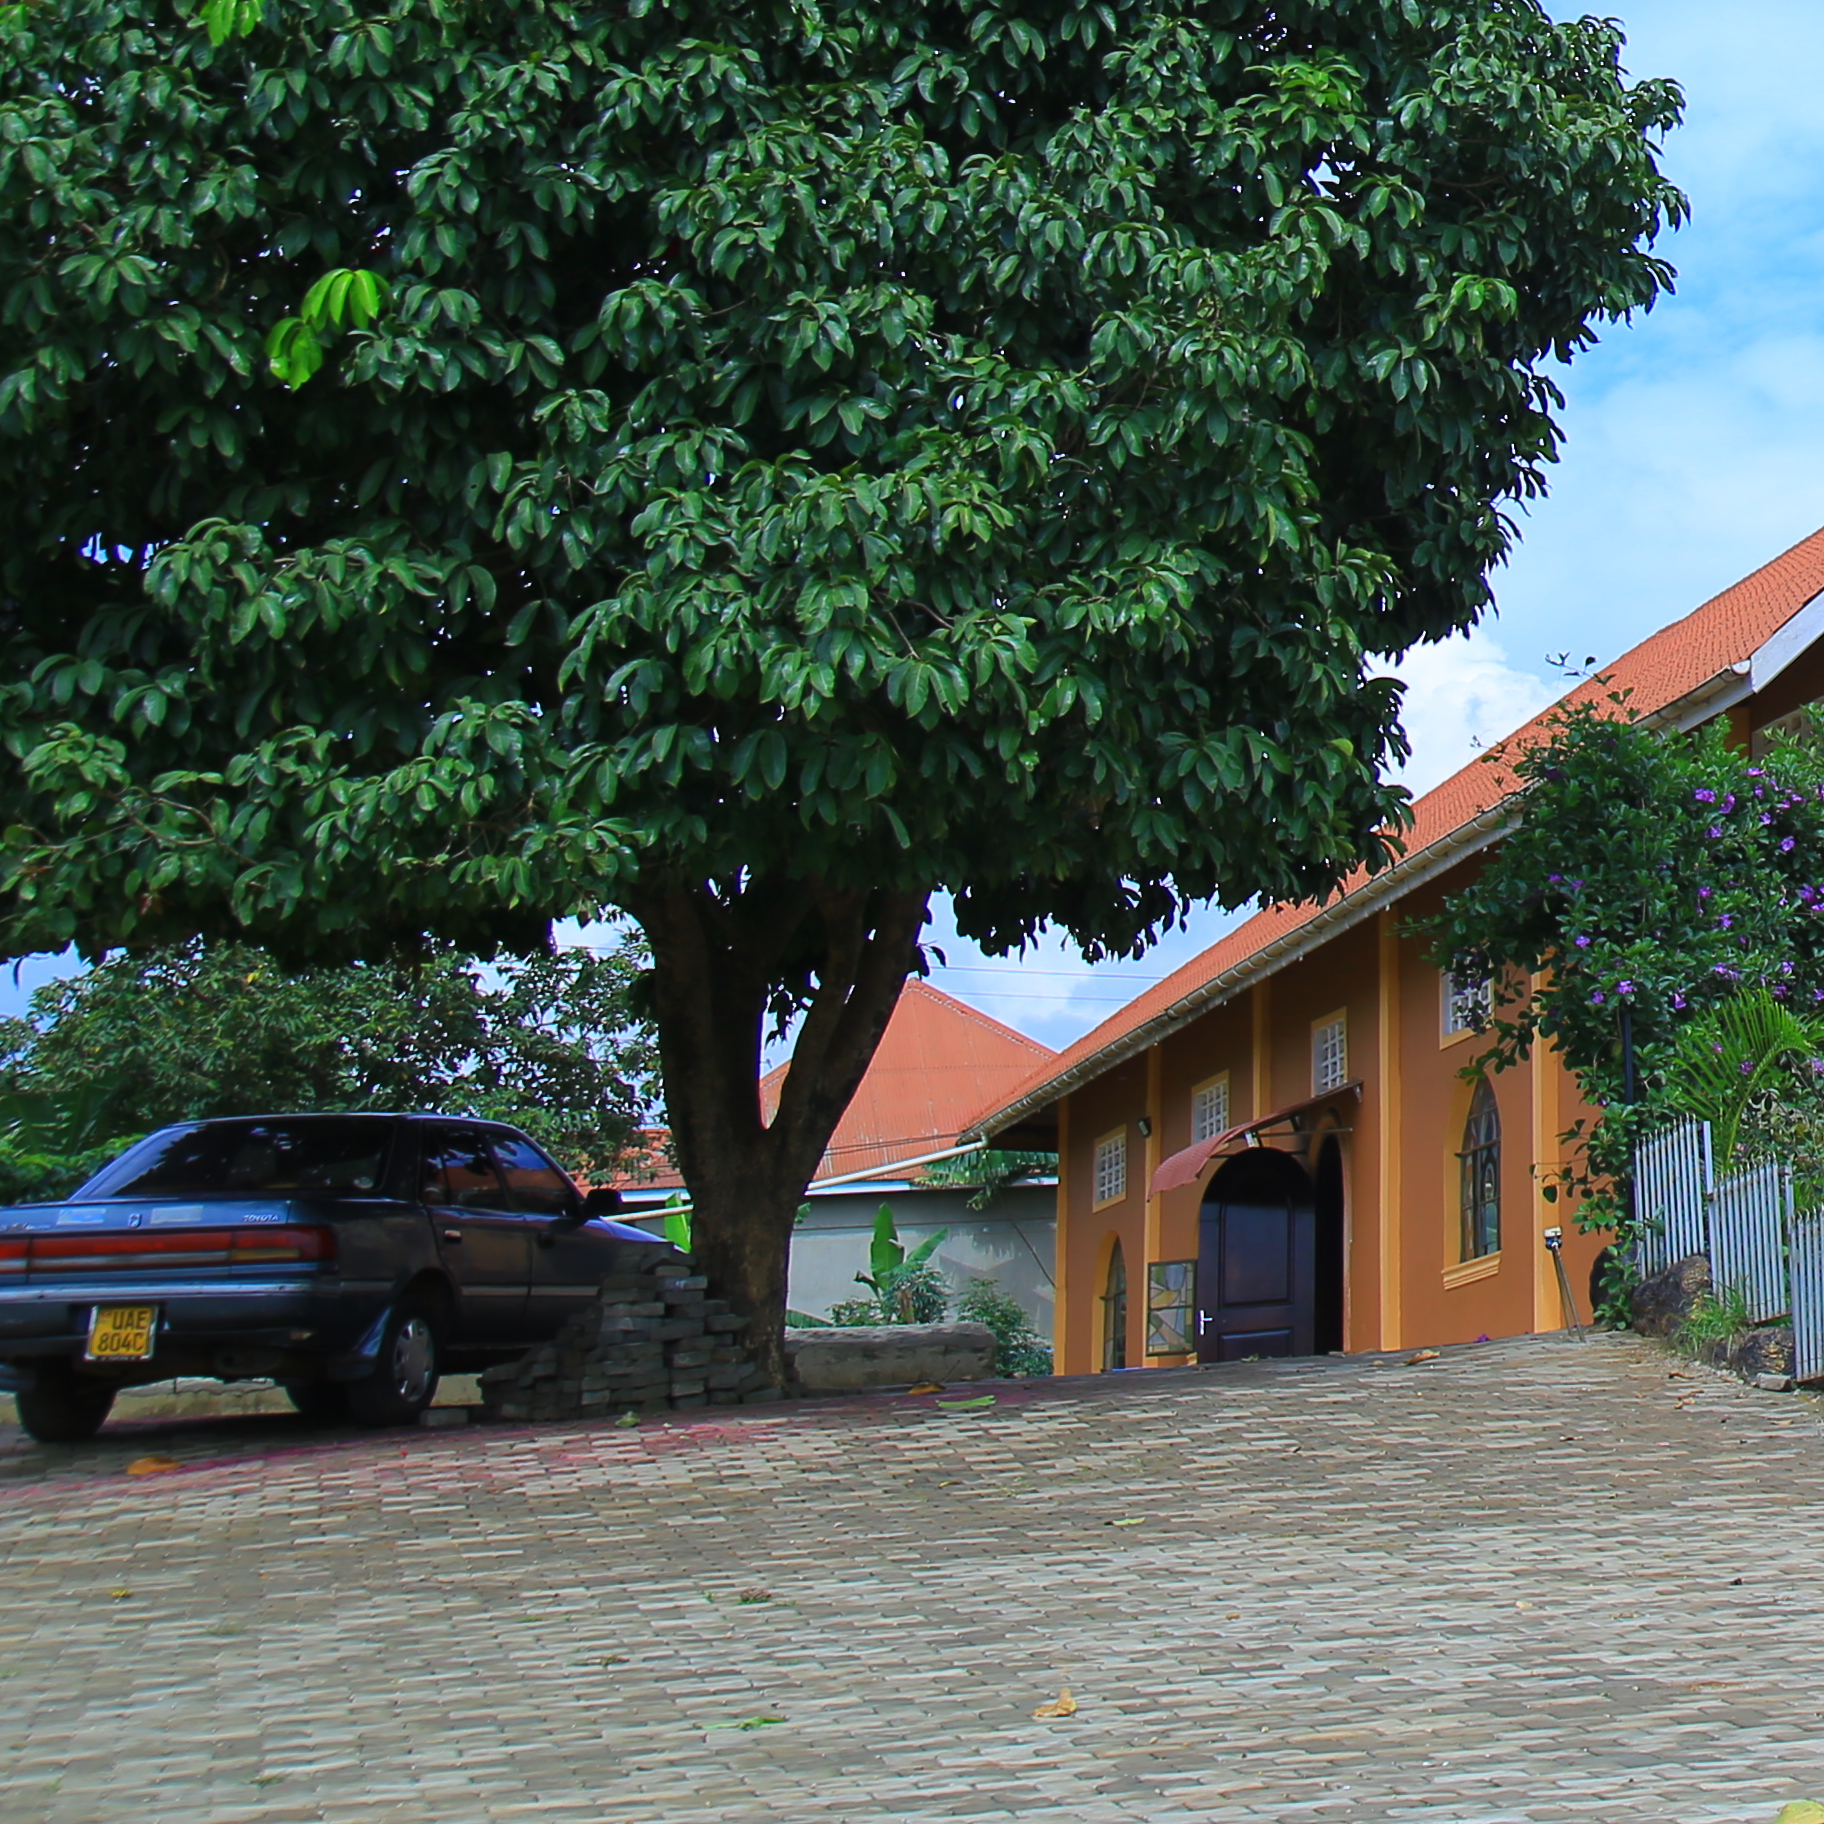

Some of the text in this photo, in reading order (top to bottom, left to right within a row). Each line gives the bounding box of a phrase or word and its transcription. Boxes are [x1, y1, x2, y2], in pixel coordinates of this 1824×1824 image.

[243, 1213, 279, 1223] TOYOTA
[112, 1309, 150, 1330] UAE
[97, 1332, 145, 1352] 804C
